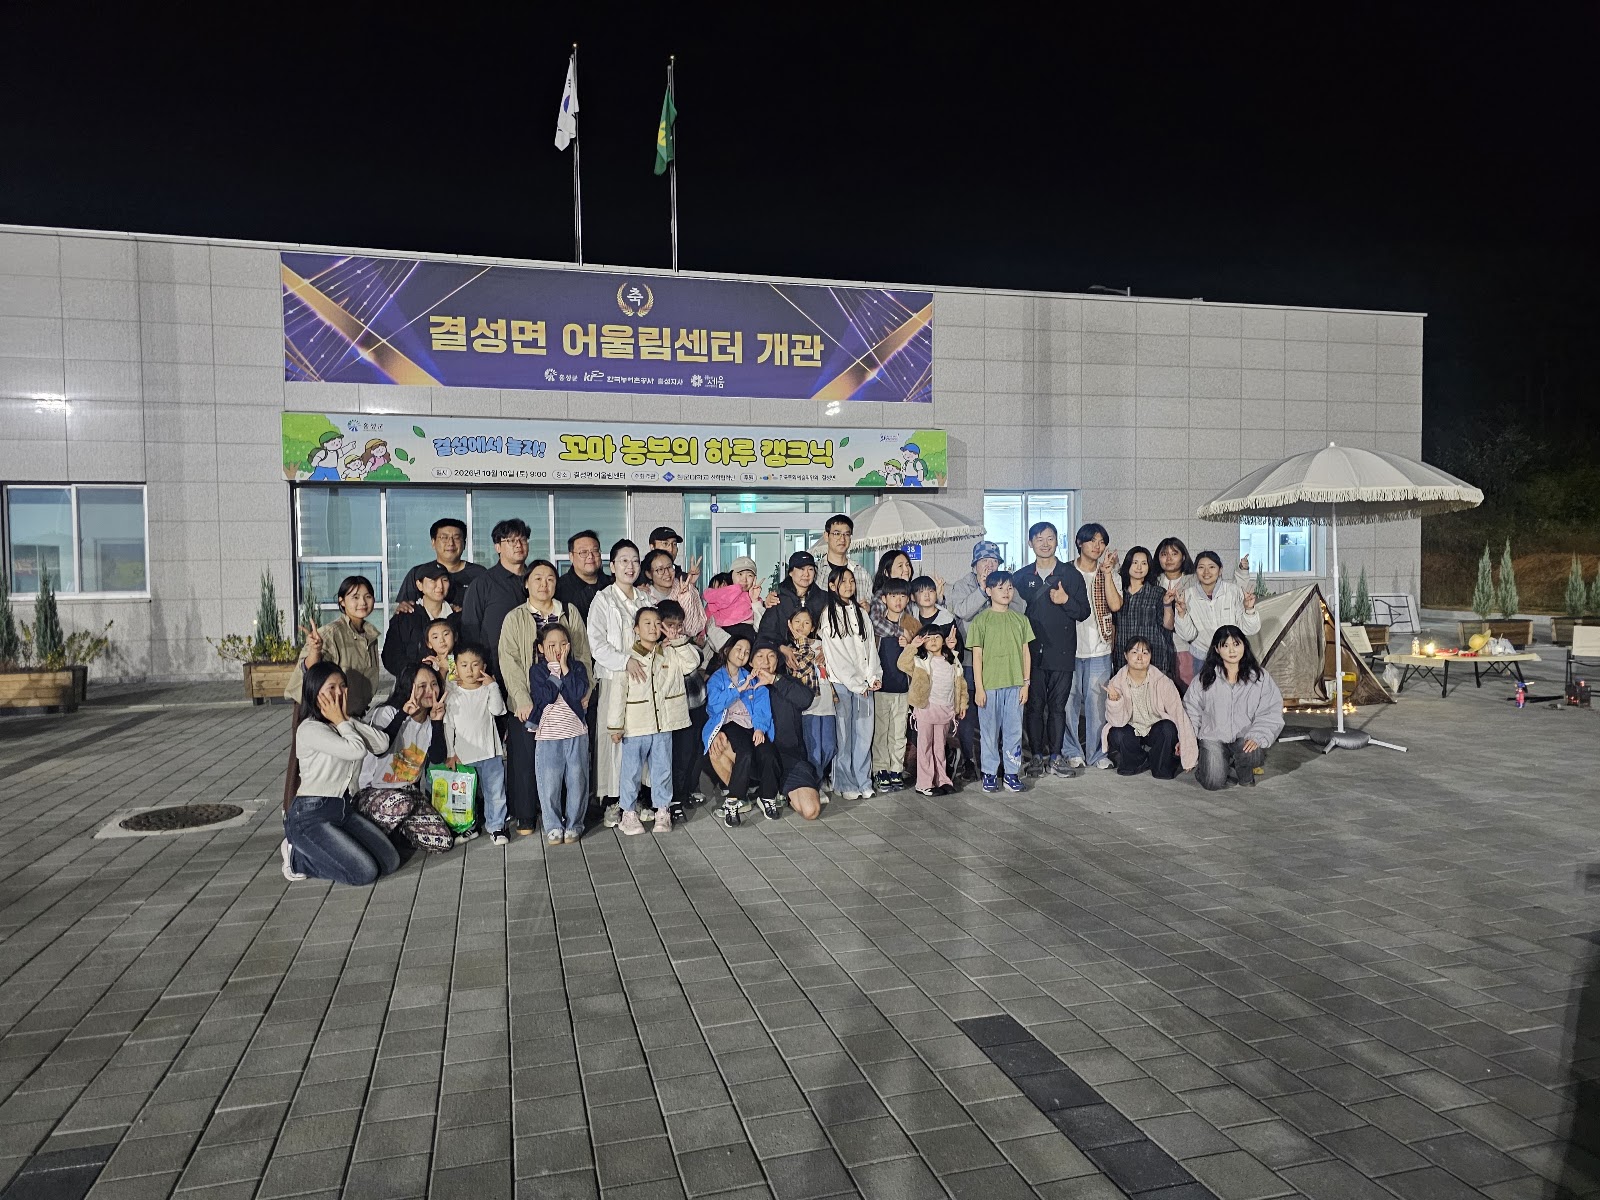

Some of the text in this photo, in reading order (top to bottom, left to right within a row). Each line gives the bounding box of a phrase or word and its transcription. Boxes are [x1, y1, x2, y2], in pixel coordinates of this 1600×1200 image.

[627, 287, 644, 307] 축
[429, 315, 825, 368] 결성면 어울림센터 개관
[433, 435, 547, 458] 결성에서 놀자!
[558, 434, 617, 464] 꼬마
[619, 434, 699, 467] 농부의
[704, 437, 757, 467] 하루
[454, 469, 481, 478] 2026년
[482, 469, 498, 478] 10월
[906, 545, 916, 553] 38
